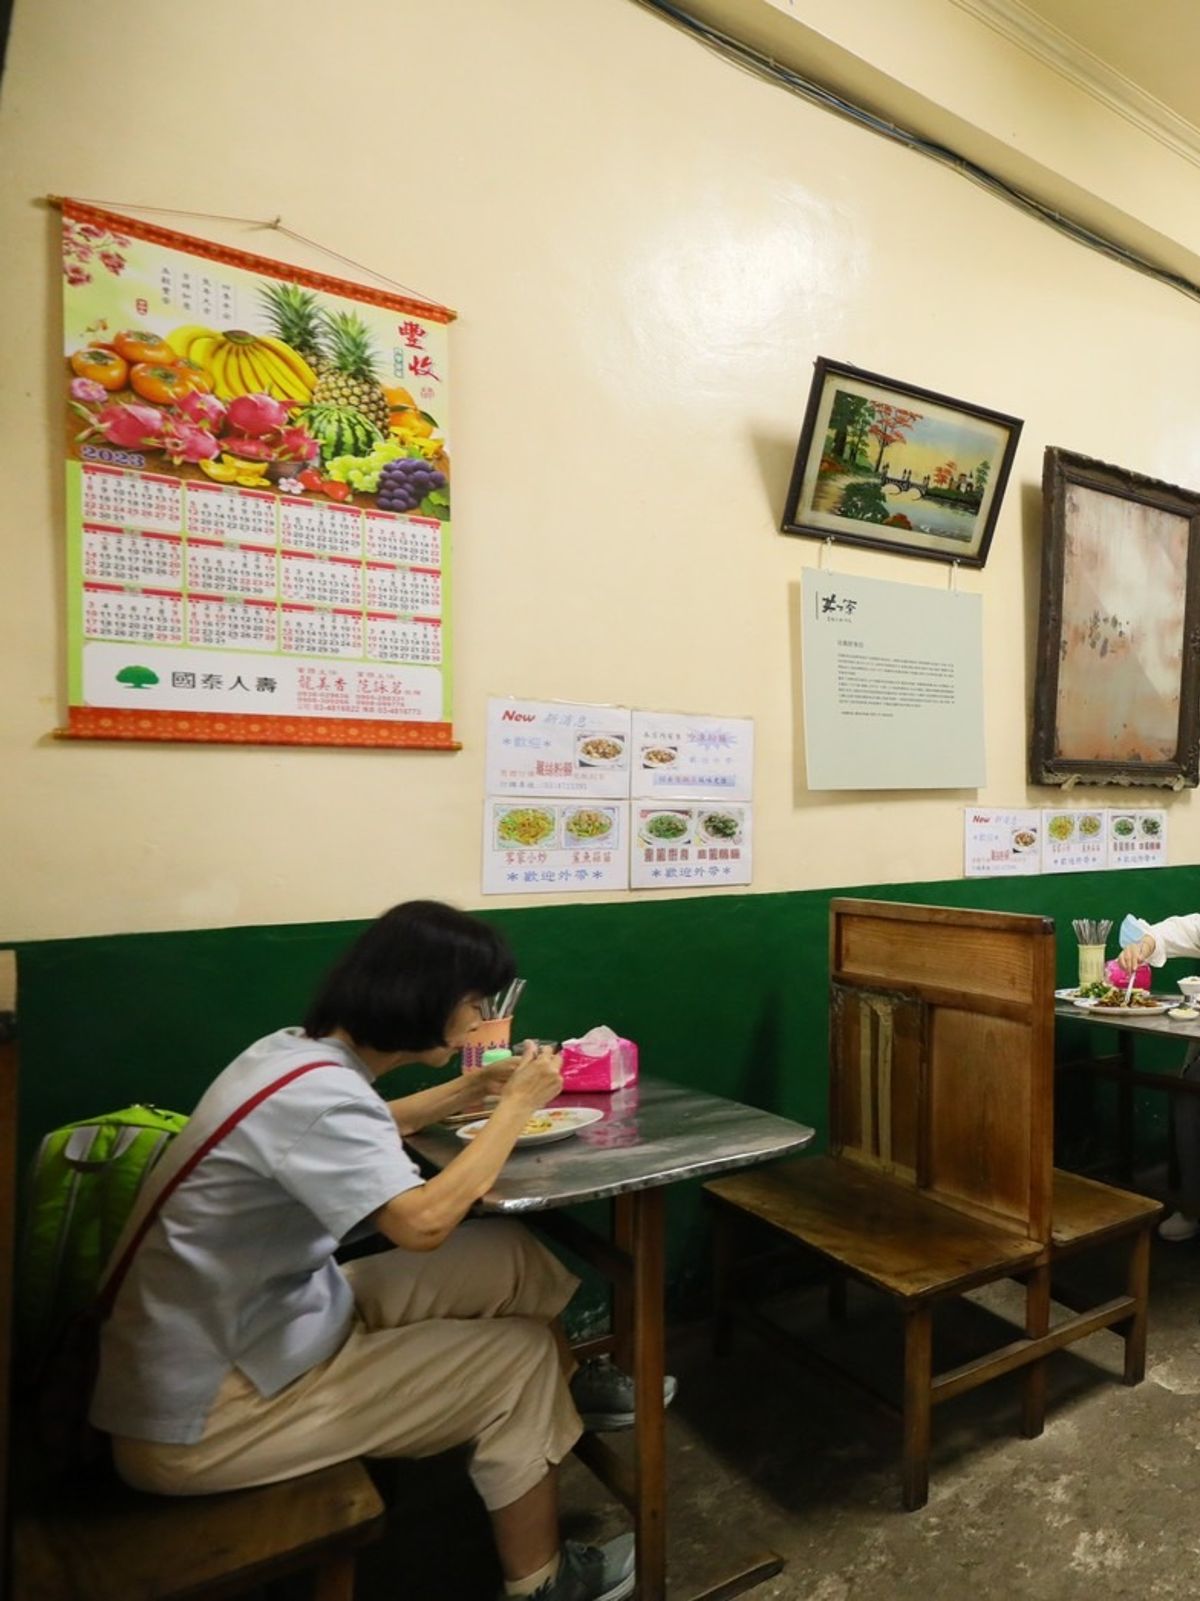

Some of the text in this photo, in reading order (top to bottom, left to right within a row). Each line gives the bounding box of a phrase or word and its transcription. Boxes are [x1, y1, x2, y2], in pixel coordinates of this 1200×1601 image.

[81, 446, 145, 468] 2023
[172, 670, 277, 694] 國泰人壽
[502, 710, 535, 722] New
[972, 815, 990, 824] New
